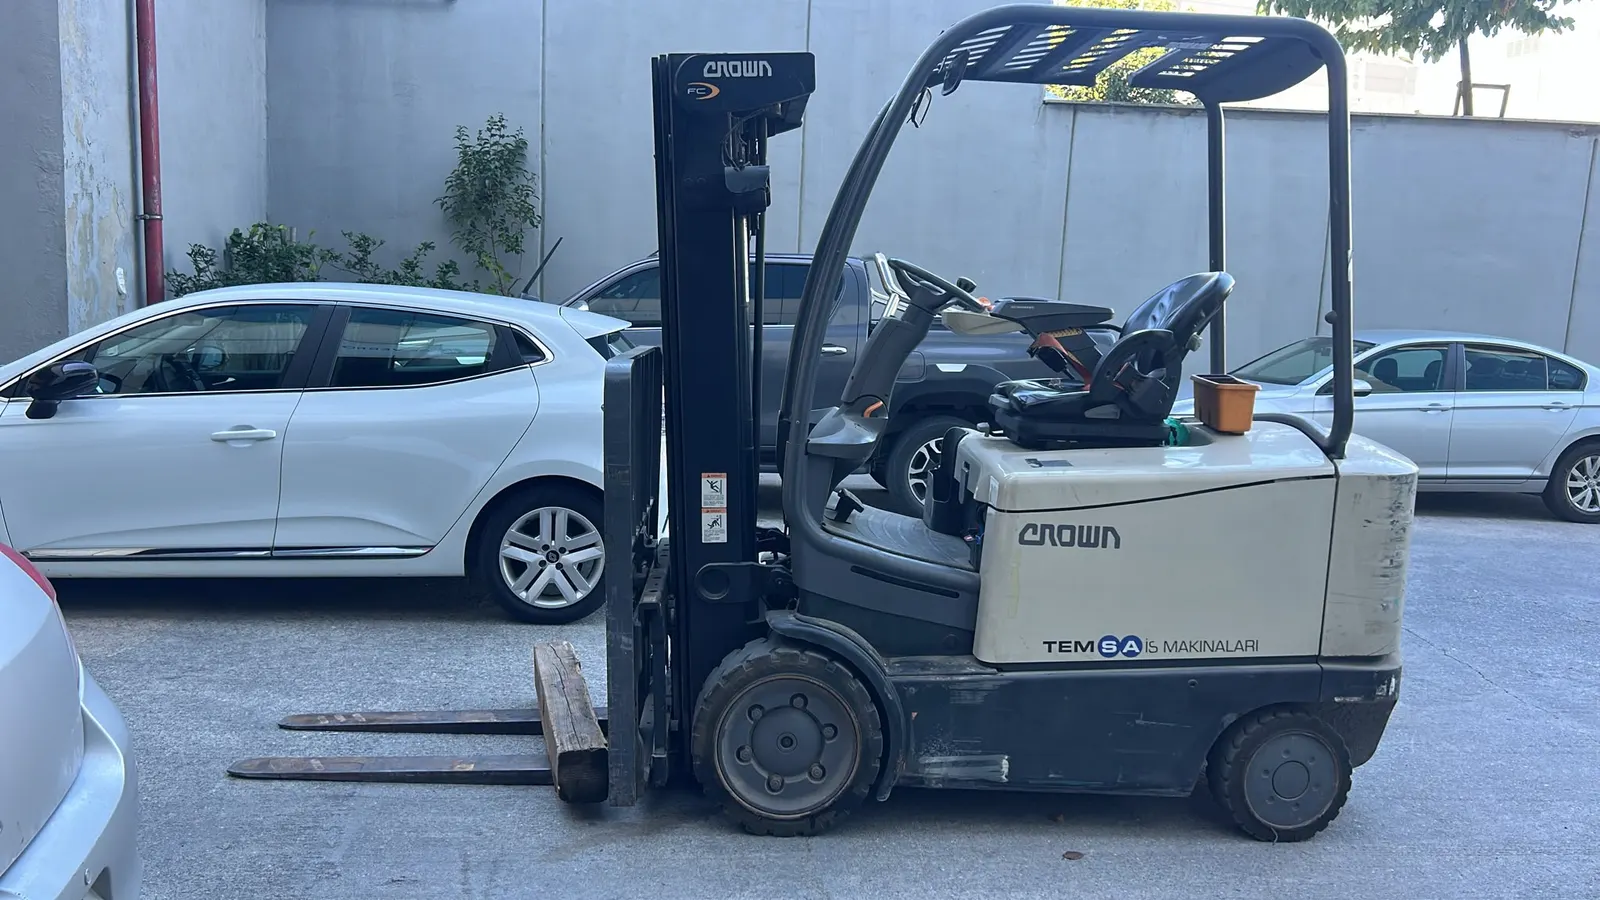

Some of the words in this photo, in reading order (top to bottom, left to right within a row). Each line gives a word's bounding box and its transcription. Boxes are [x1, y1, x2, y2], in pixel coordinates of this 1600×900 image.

[703, 60, 772, 78] CROWN
[687, 87, 706, 95] FC
[1018, 523, 1121, 549] CROWN
[1042, 636, 1142, 656] TEMSA
[1163, 639, 1260, 653] MAKINALARI
